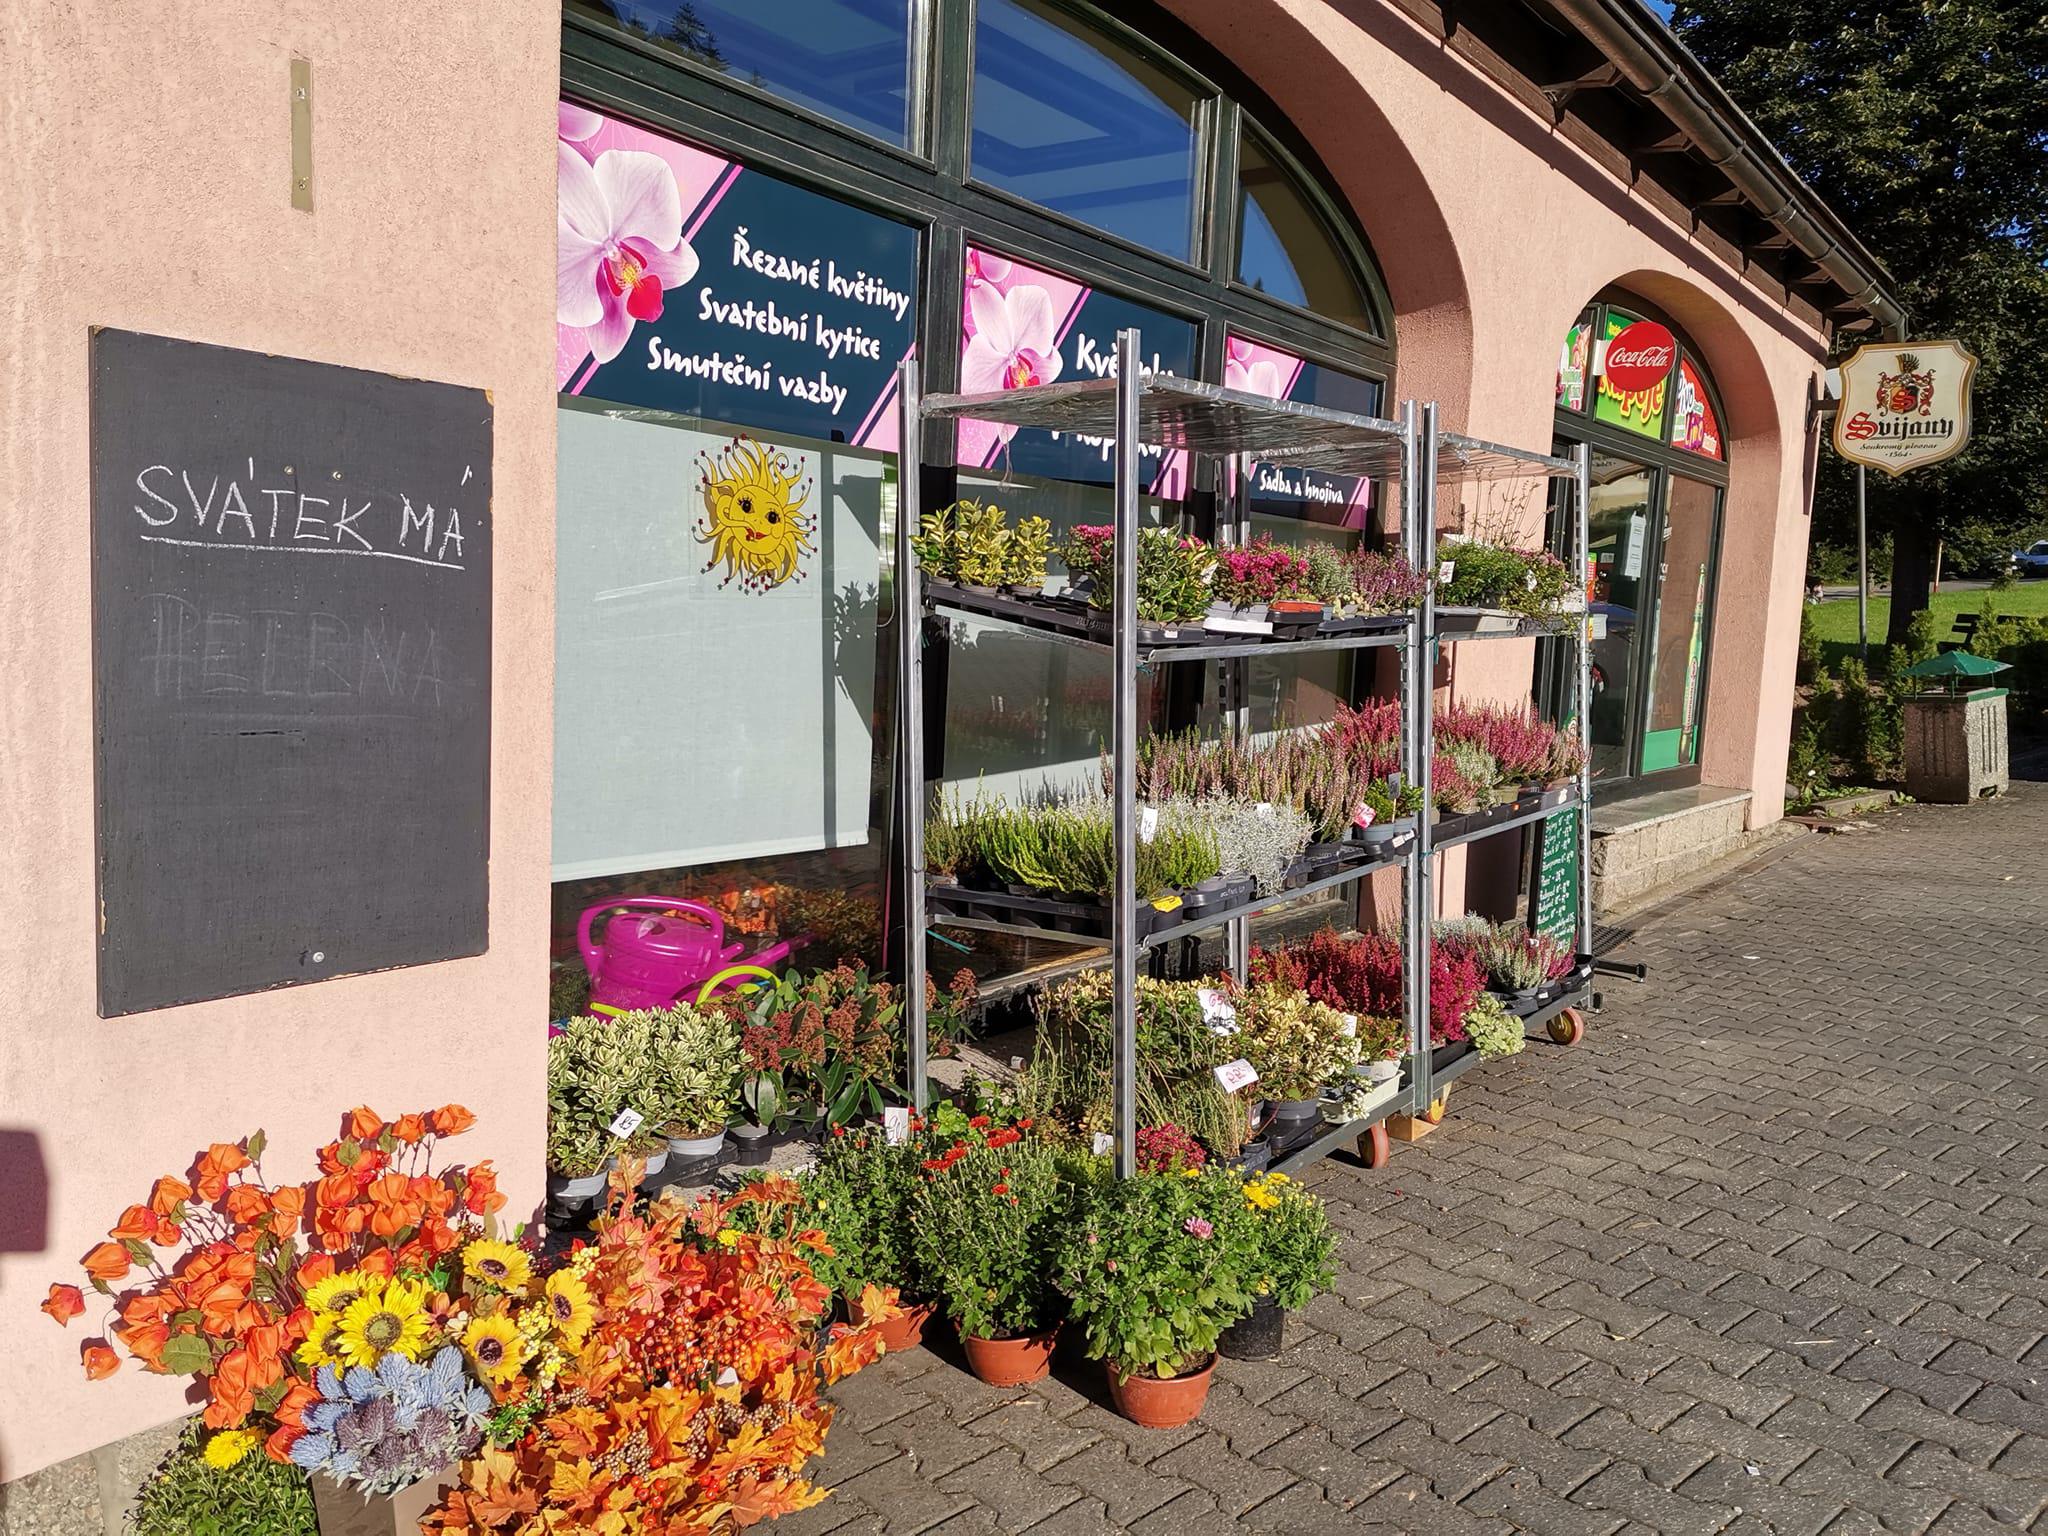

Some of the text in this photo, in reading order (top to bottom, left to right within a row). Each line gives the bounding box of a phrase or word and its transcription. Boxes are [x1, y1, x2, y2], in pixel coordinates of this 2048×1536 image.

[733, 226, 910, 321] Řezané květiny
[699, 287, 881, 360] Svatební kytice
[1609, 346, 1674, 368] Coca-Cola
[647, 336, 848, 415] Smuteční vazby
[1845, 411, 1954, 441] Svijany
[134, 456, 473, 560] SVÁTEK MÁ
[1260, 469, 1344, 508] Sadba a hnojiva
